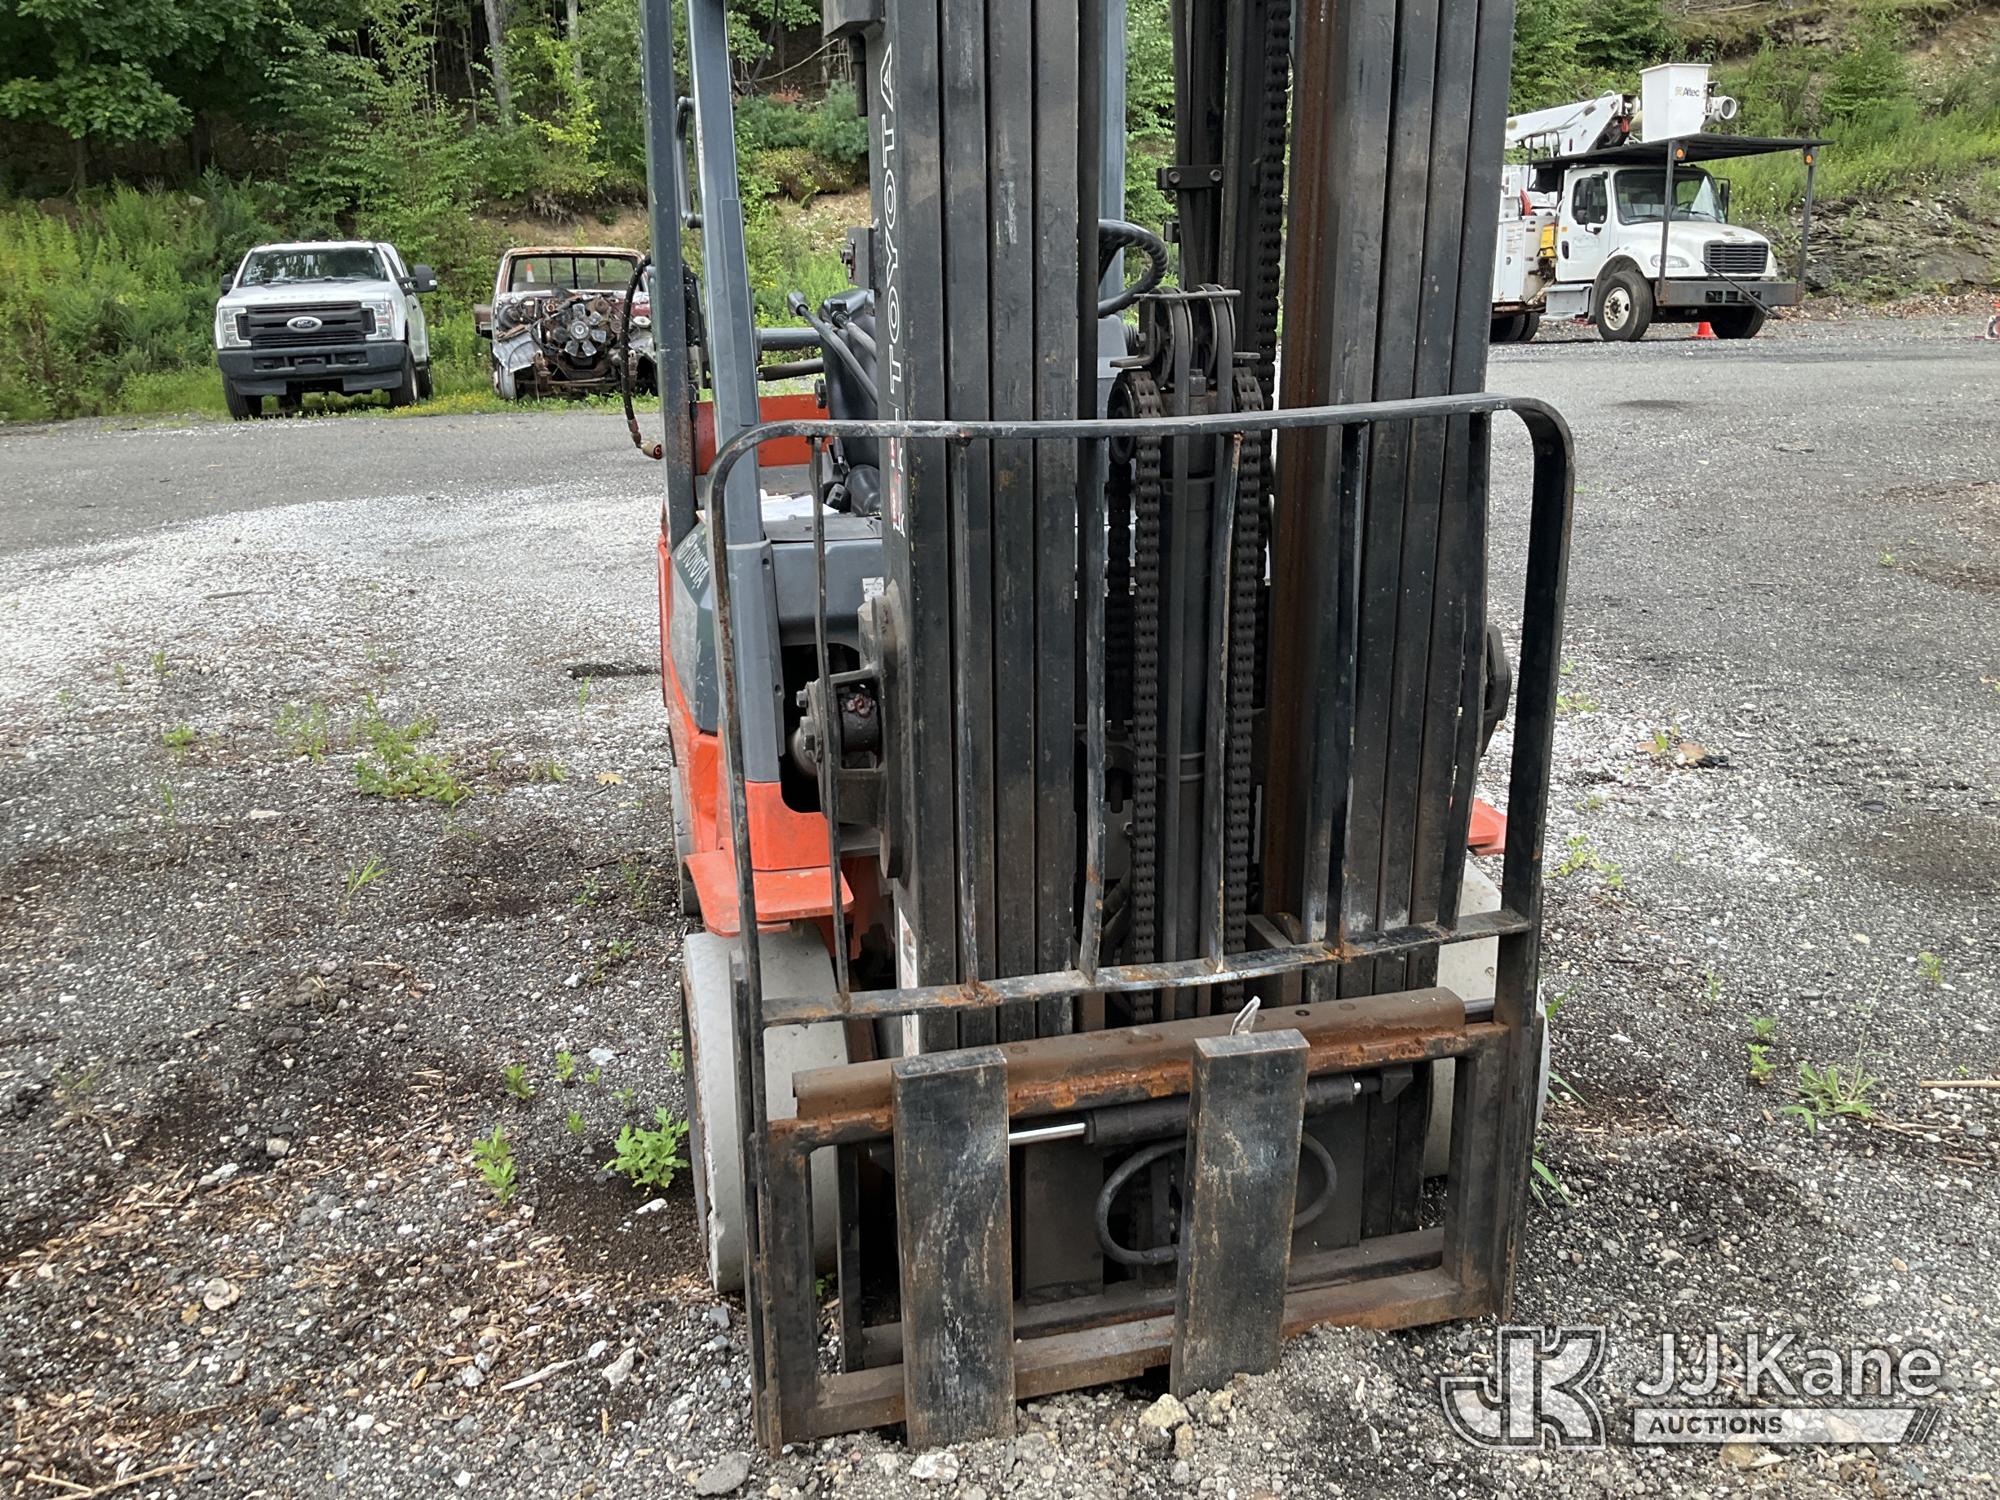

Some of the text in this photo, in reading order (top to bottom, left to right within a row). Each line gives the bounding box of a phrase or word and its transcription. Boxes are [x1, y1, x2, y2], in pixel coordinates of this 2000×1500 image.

[1682, 87, 1700, 97] Altec
[880, 41, 902, 394] TOYOTA
[683, 543, 710, 589] TOYOTA
